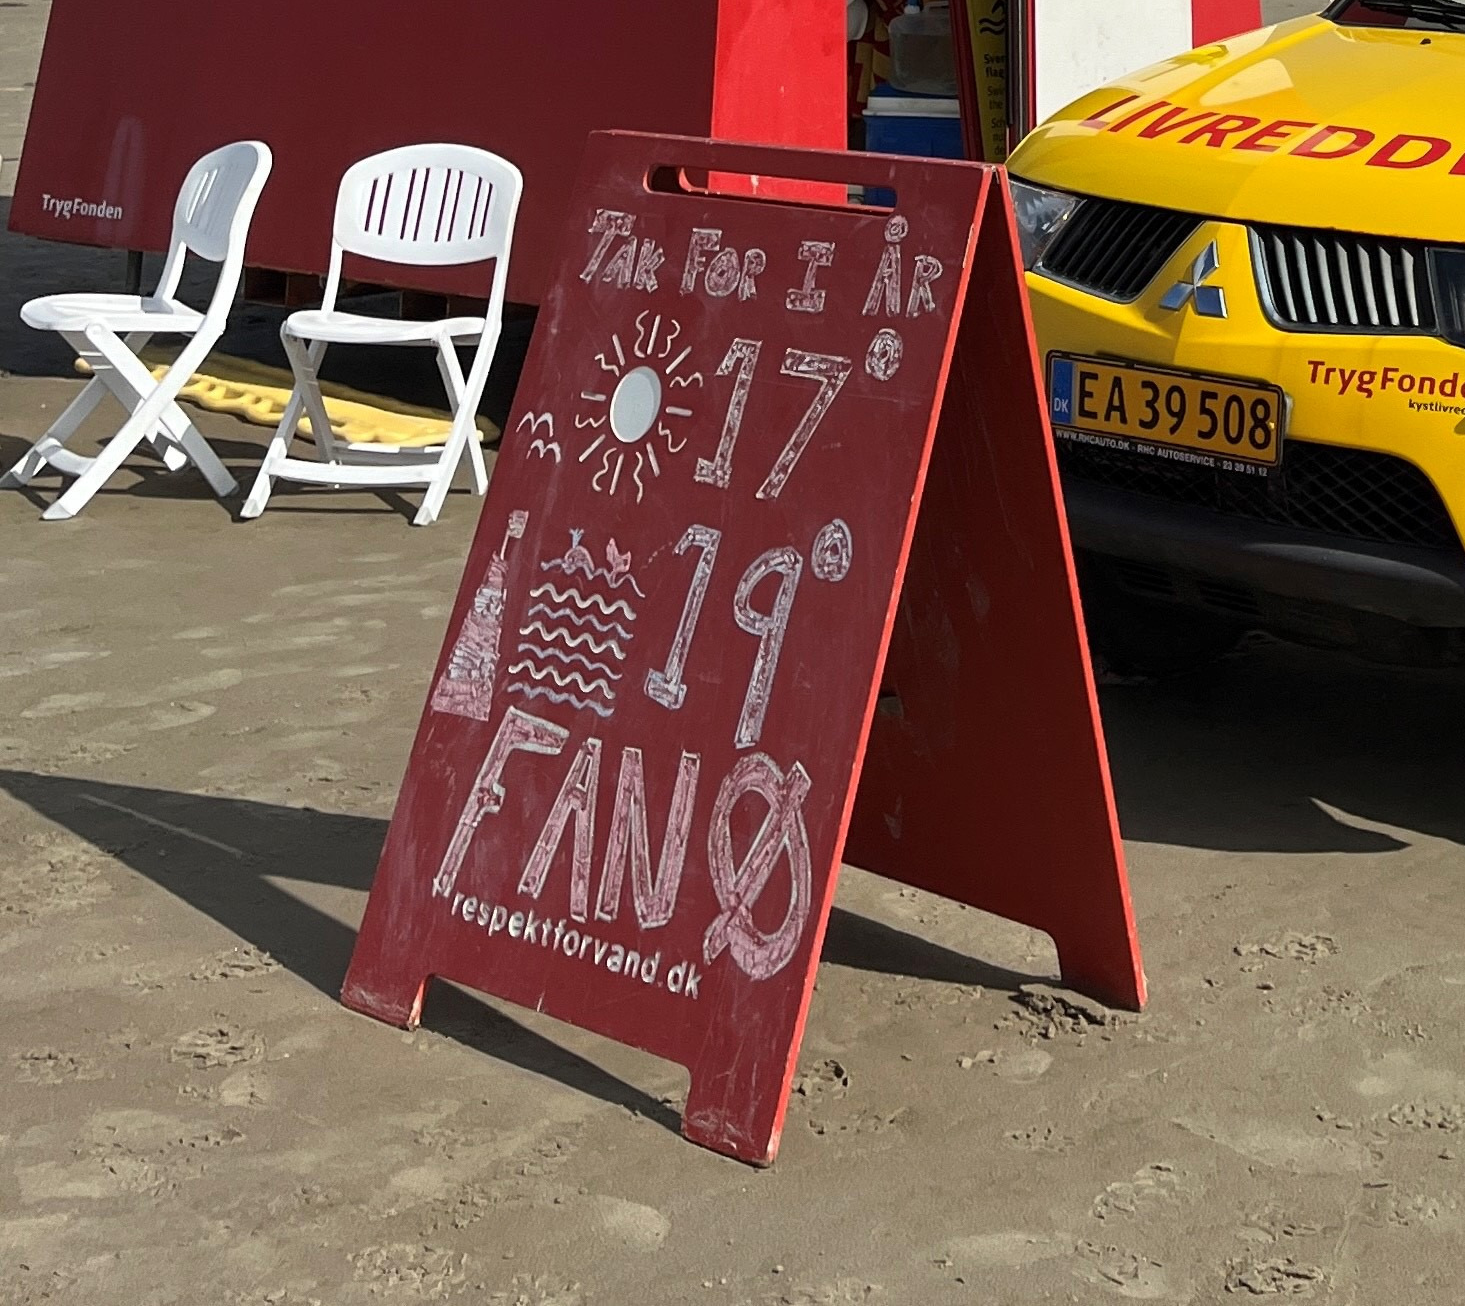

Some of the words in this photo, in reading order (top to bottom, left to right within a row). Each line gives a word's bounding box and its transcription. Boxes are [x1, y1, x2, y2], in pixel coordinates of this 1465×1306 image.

[42, 193, 123, 220] TrygFonden
[785, 241, 836, 313] I
[1053, 397, 1069, 414] DK
[1077, 370, 1128, 425] EA
[1138, 380, 1187, 436] 39
[1197, 389, 1273, 451] 508
[1055, 428, 1130, 451] WWW.RHCAUTO.DK
[1137, 443, 1155, 456] RHC
[1157, 448, 1215, 468] AUTOSERVICE
[431, 705, 813, 982] FANØ
[451, 889, 703, 1000] respektforvand.dk
